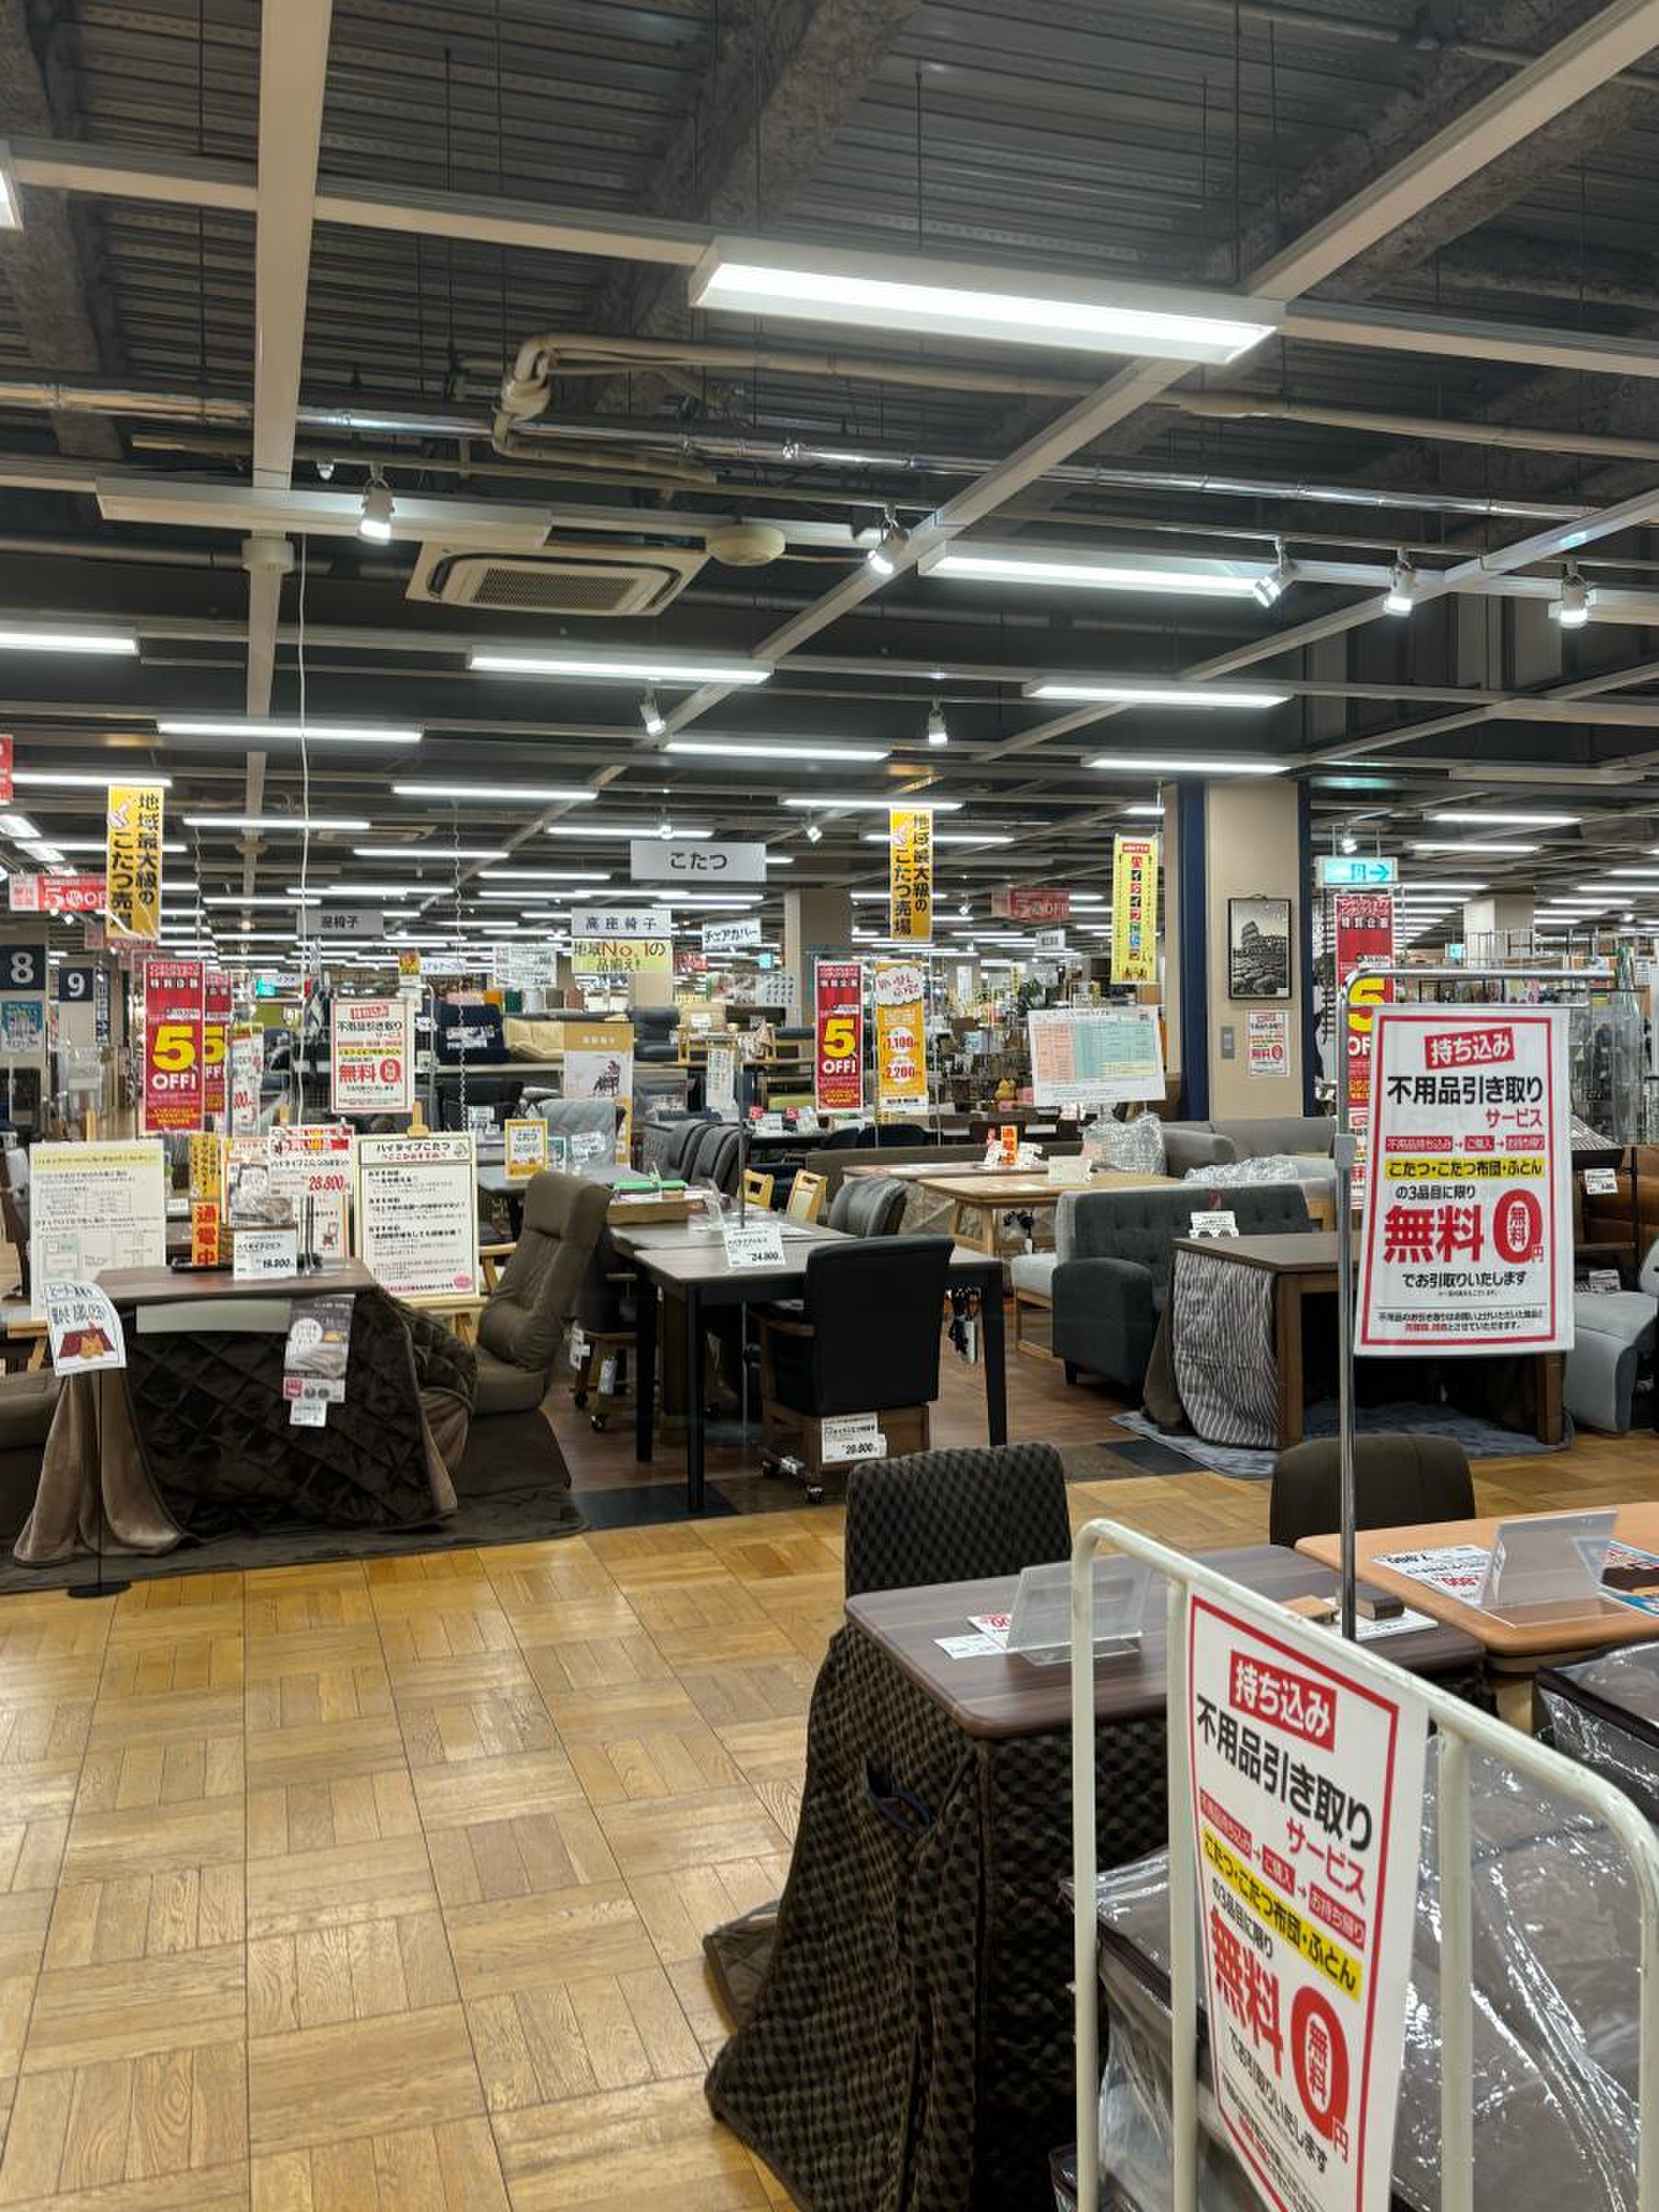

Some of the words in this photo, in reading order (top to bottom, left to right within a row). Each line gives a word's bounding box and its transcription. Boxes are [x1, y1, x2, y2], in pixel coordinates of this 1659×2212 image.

[137, 794, 159, 905] 地域最大級の
[670, 852, 728, 870] こたつ
[913, 815, 930, 912] 地域最大級の
[894, 849, 912, 936] こたつ売場
[586, 916, 657, 930] 高座椅子
[11, 953, 34, 983] 8
[67, 973, 85, 997] 9
[822, 1061, 856, 1074] OFF!
[1430, 1036, 1512, 1063] 持ち込み
[1387, 1076, 1544, 1105] 不用品引き取り
[1486, 1108, 1544, 1129] サービス
[1389, 1159, 1543, 1178] こたつ・こたつ布団・ふとん
[1395, 1185, 1476, 1200] の3品目に限り
[1383, 1204, 1485, 1264] 無料
[1493, 1189, 1543, 1264] 0
[1510, 1206, 1528, 1246] 無料
[1402, 1271, 1527, 1289] でお引取りいたします
[1532, 1245, 1545, 1264] 円
[1234, 1660, 1332, 1739] 持ち込み
[1196, 1695, 1372, 1852] 不用品引き取り
[1287, 1817, 1365, 1904] サービス
[1205, 1832, 1357, 1991] こたつ・こたつ布団・ふとん
[1213, 1878, 1273, 1959] の3品目に限り
[1311, 1892, 1364, 1945] お持ち帰り
[1210, 1905, 1283, 2078] 無料
[1291, 1986, 1349, 2141] 0
[1310, 2020, 1328, 2106] 無料
[1230, 2025, 1327, 2174] でお引取りいたします
[1332, 2116, 1348, 2163] 円
